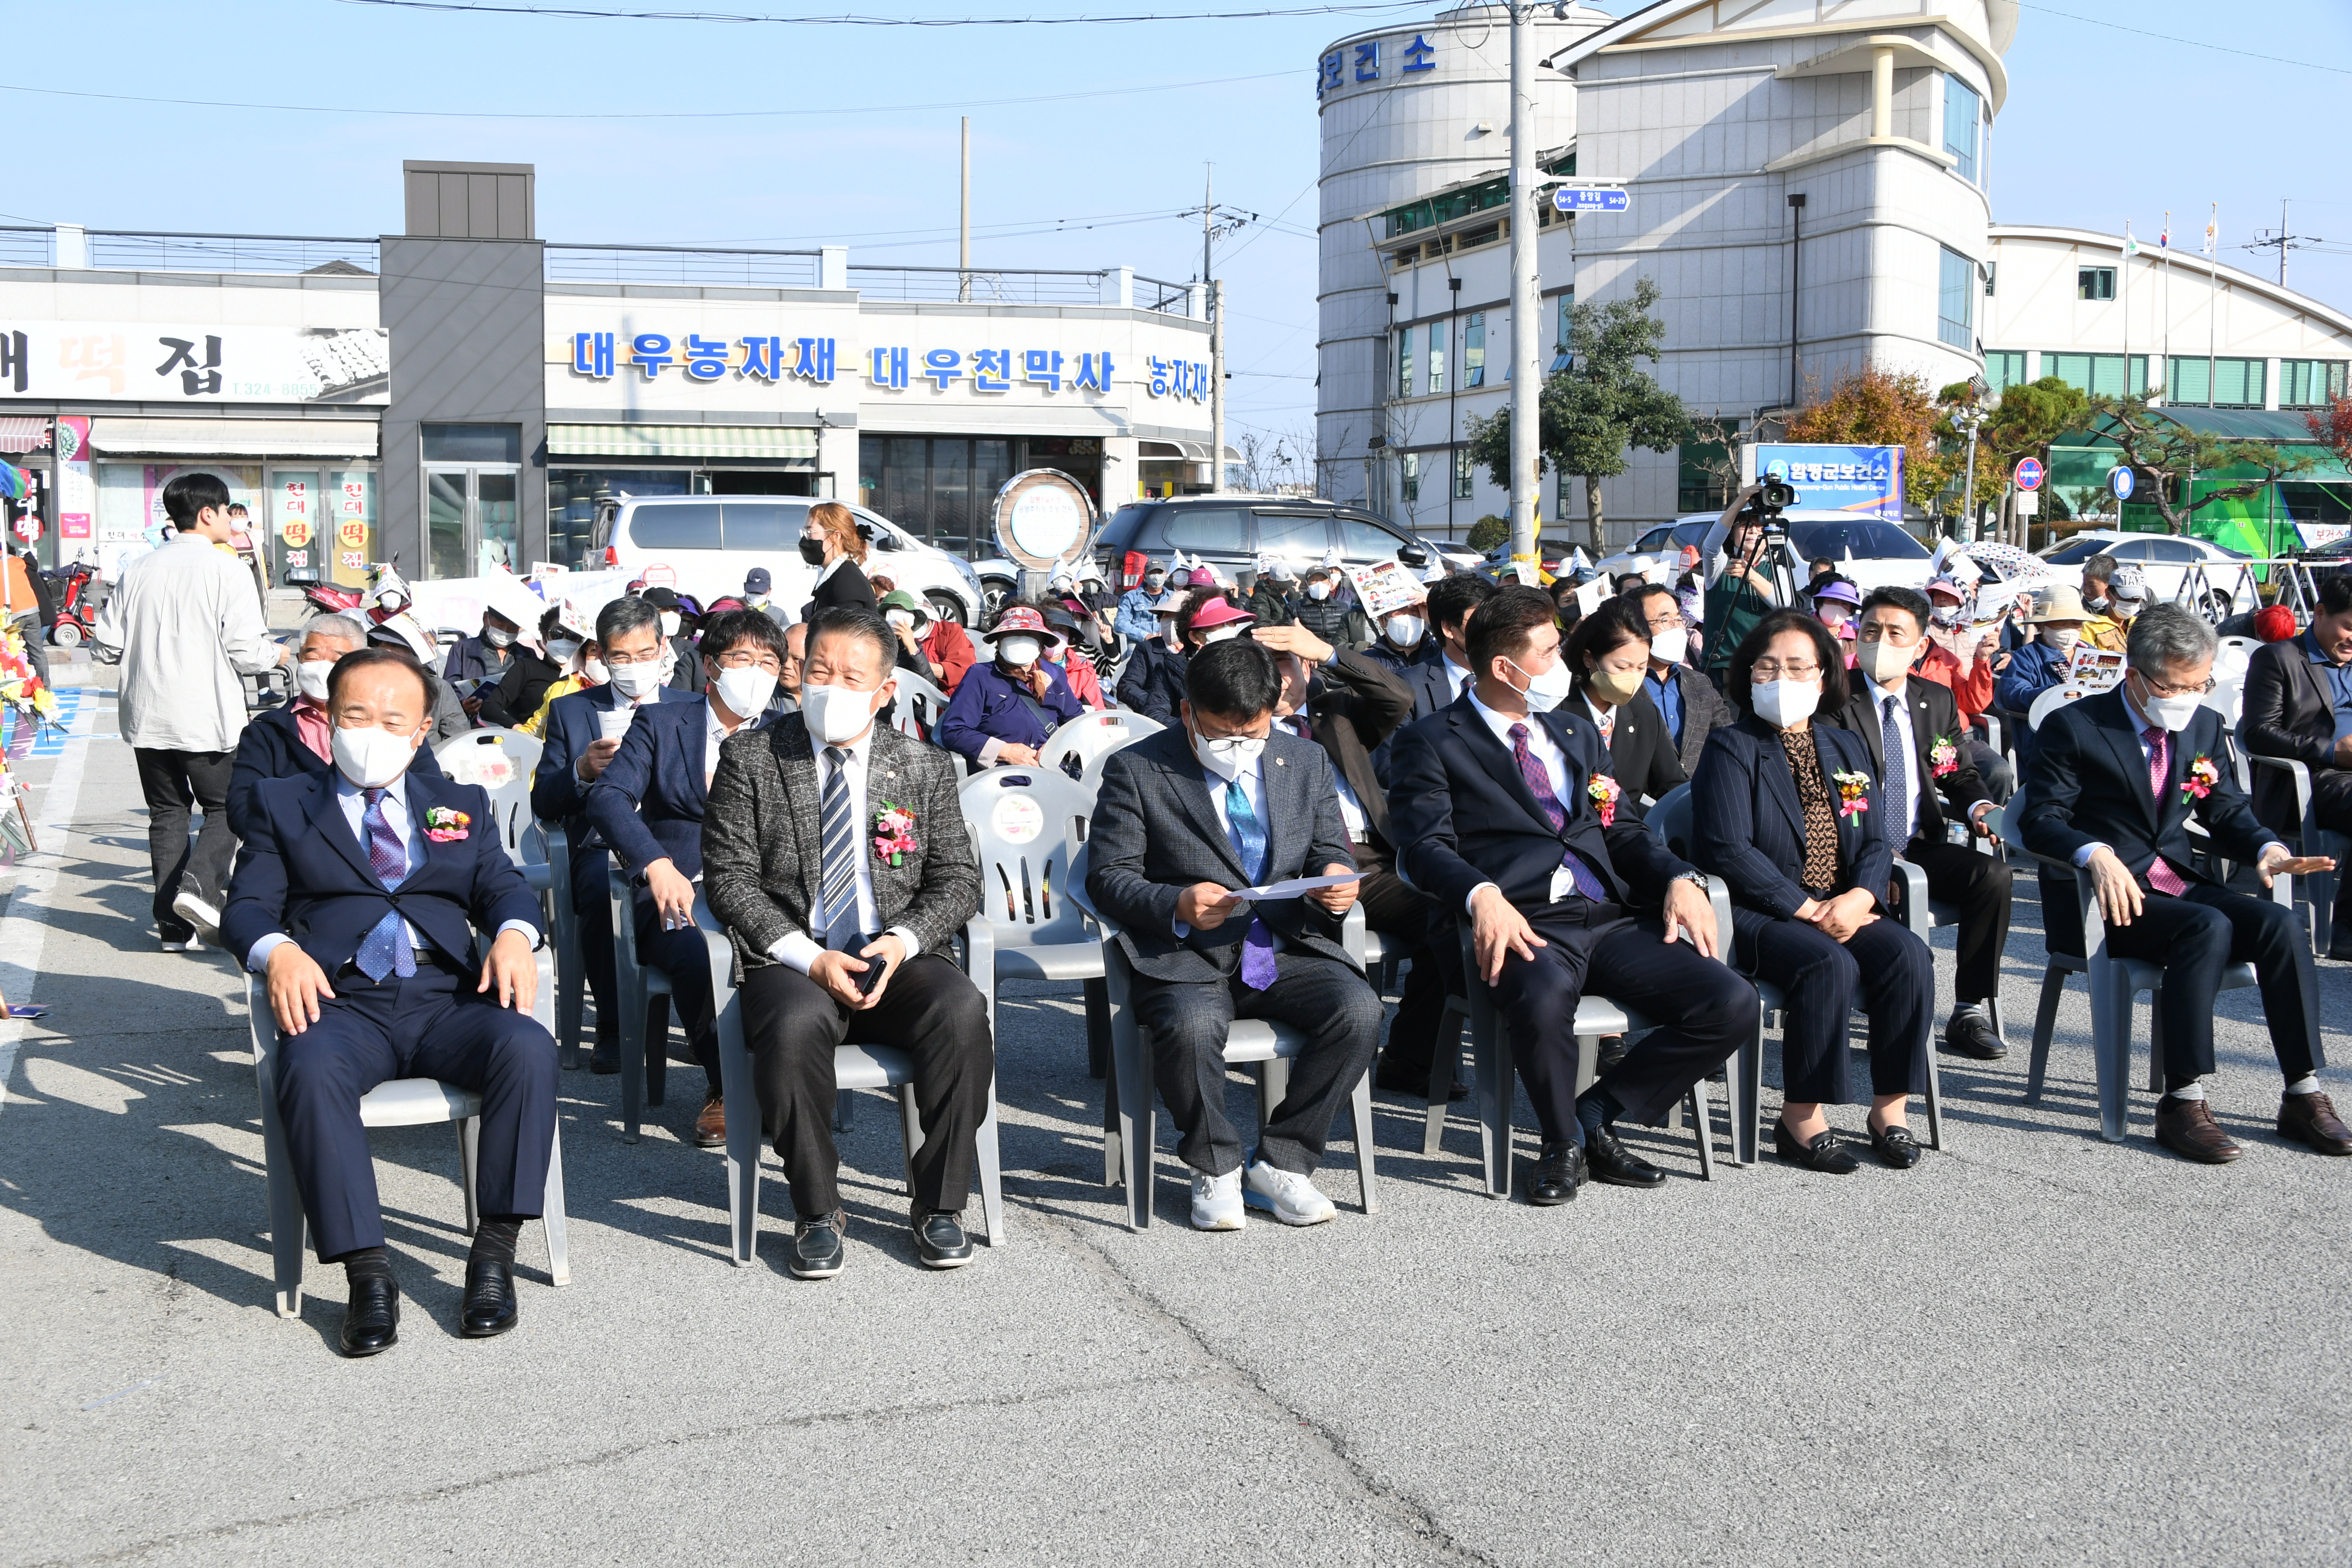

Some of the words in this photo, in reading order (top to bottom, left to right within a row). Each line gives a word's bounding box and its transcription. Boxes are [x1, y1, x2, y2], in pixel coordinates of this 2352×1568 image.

[1579, 192, 1601, 201] 중앙길
[576, 332, 835, 381] 대우농자재
[874, 347, 1114, 392] 대우천막사
[1152, 355, 1207, 401] 농자재
[1791, 463, 1888, 480] 함평군보건소
[2121, 574, 2144, 587] TAKE
